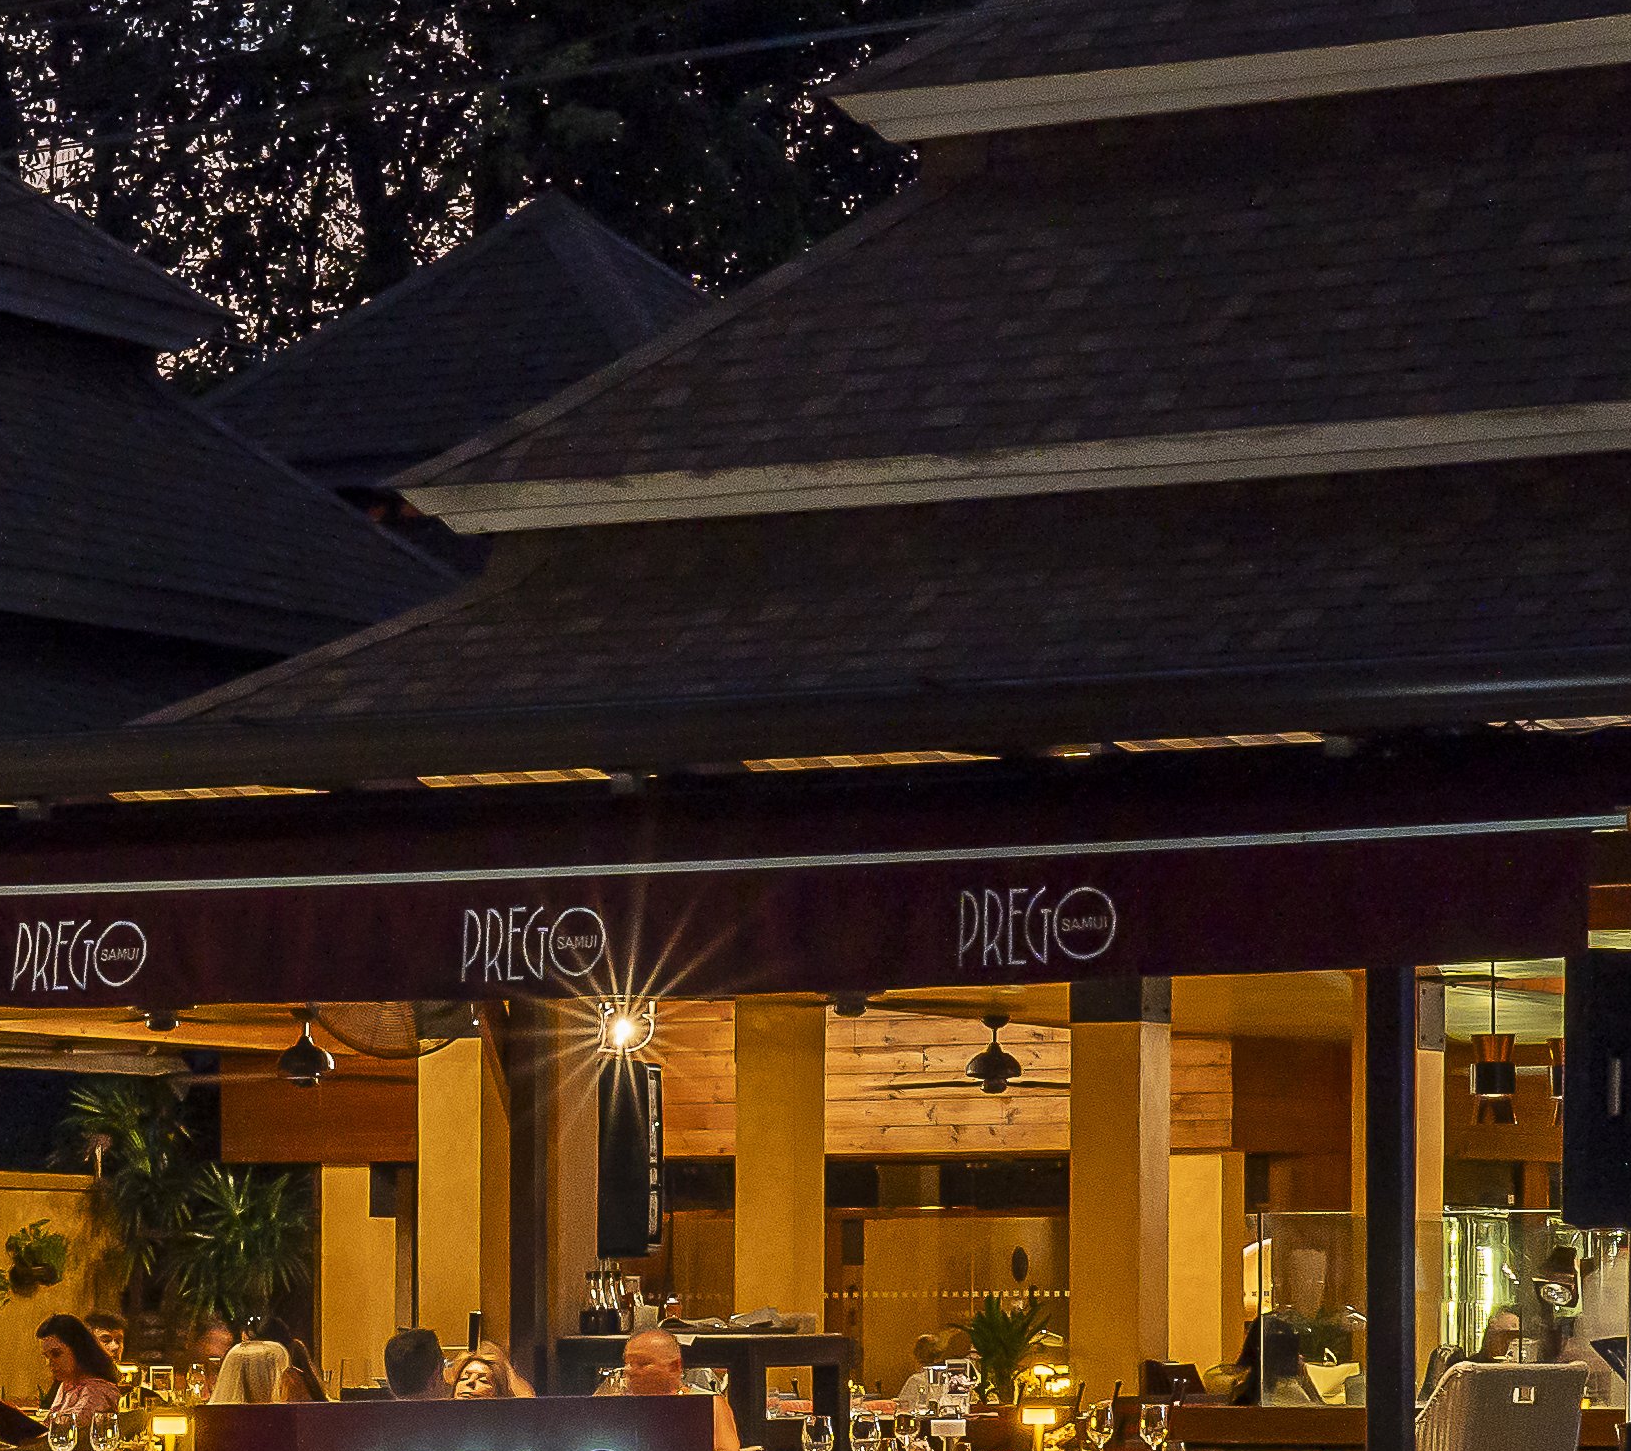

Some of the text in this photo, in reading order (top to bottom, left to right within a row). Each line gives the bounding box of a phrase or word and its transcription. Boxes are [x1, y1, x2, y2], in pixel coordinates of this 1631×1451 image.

[461, 905, 607, 982] PREGO
[557, 935, 598, 950] SAMUI
[958, 886, 1117, 966] PREGO
[1060, 916, 1108, 932] SAMUI
[11, 919, 147, 992] PREGO
[100, 948, 140, 962] SAMUI
